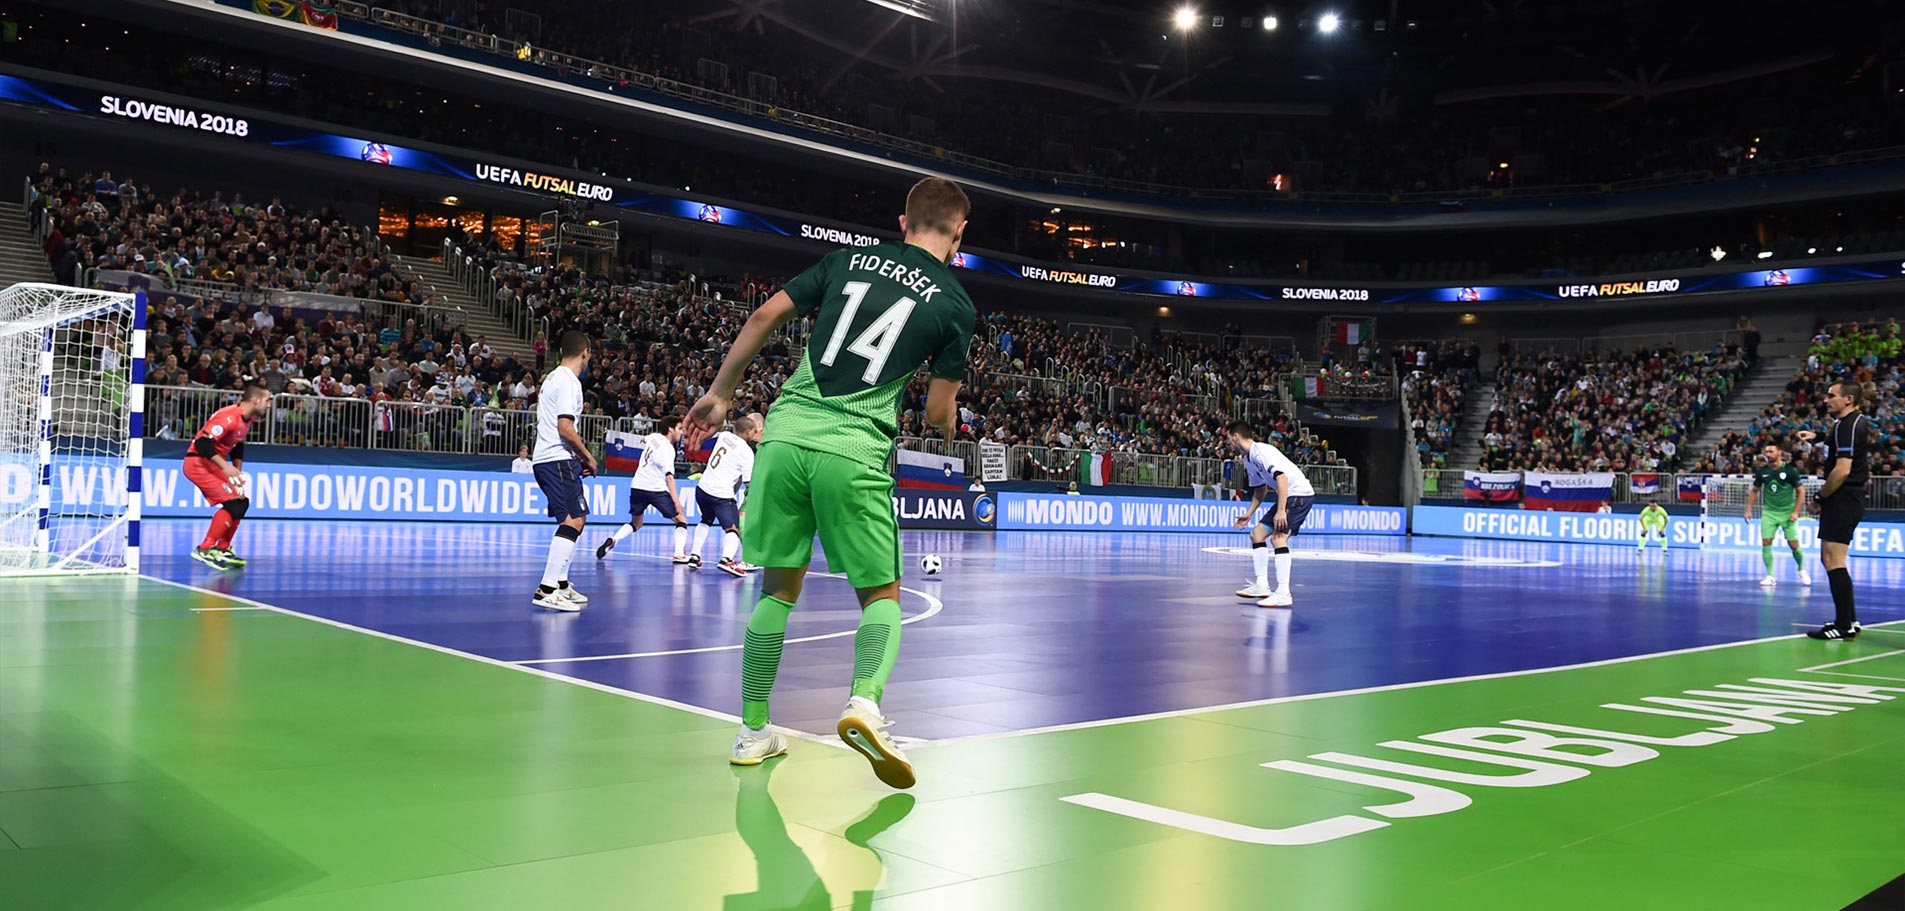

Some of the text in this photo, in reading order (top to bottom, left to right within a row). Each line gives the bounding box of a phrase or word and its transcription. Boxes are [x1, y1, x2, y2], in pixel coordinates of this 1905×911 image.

[100, 95, 248, 137] SLOVENIA 2018
[475, 162, 521, 186] UEFA
[800, 224, 853, 246] SLOVENIA
[848, 252, 943, 304] FIDERŠEK
[1021, 264, 1048, 281] UEFA
[1282, 287, 1369, 301] SLOVENIA 2018
[1558, 285, 1598, 298] UEFA
[820, 280, 917, 386] 14
[710, 446, 727, 470] 6
[1771, 484, 1778, 493] 9
[1026, 499, 1114, 525] MONDO
[1342, 509, 1401, 531] MONDO
[1463, 511, 1553, 537] OFFICIAL
[1059, 677, 1905, 846] LJUBLJANA
